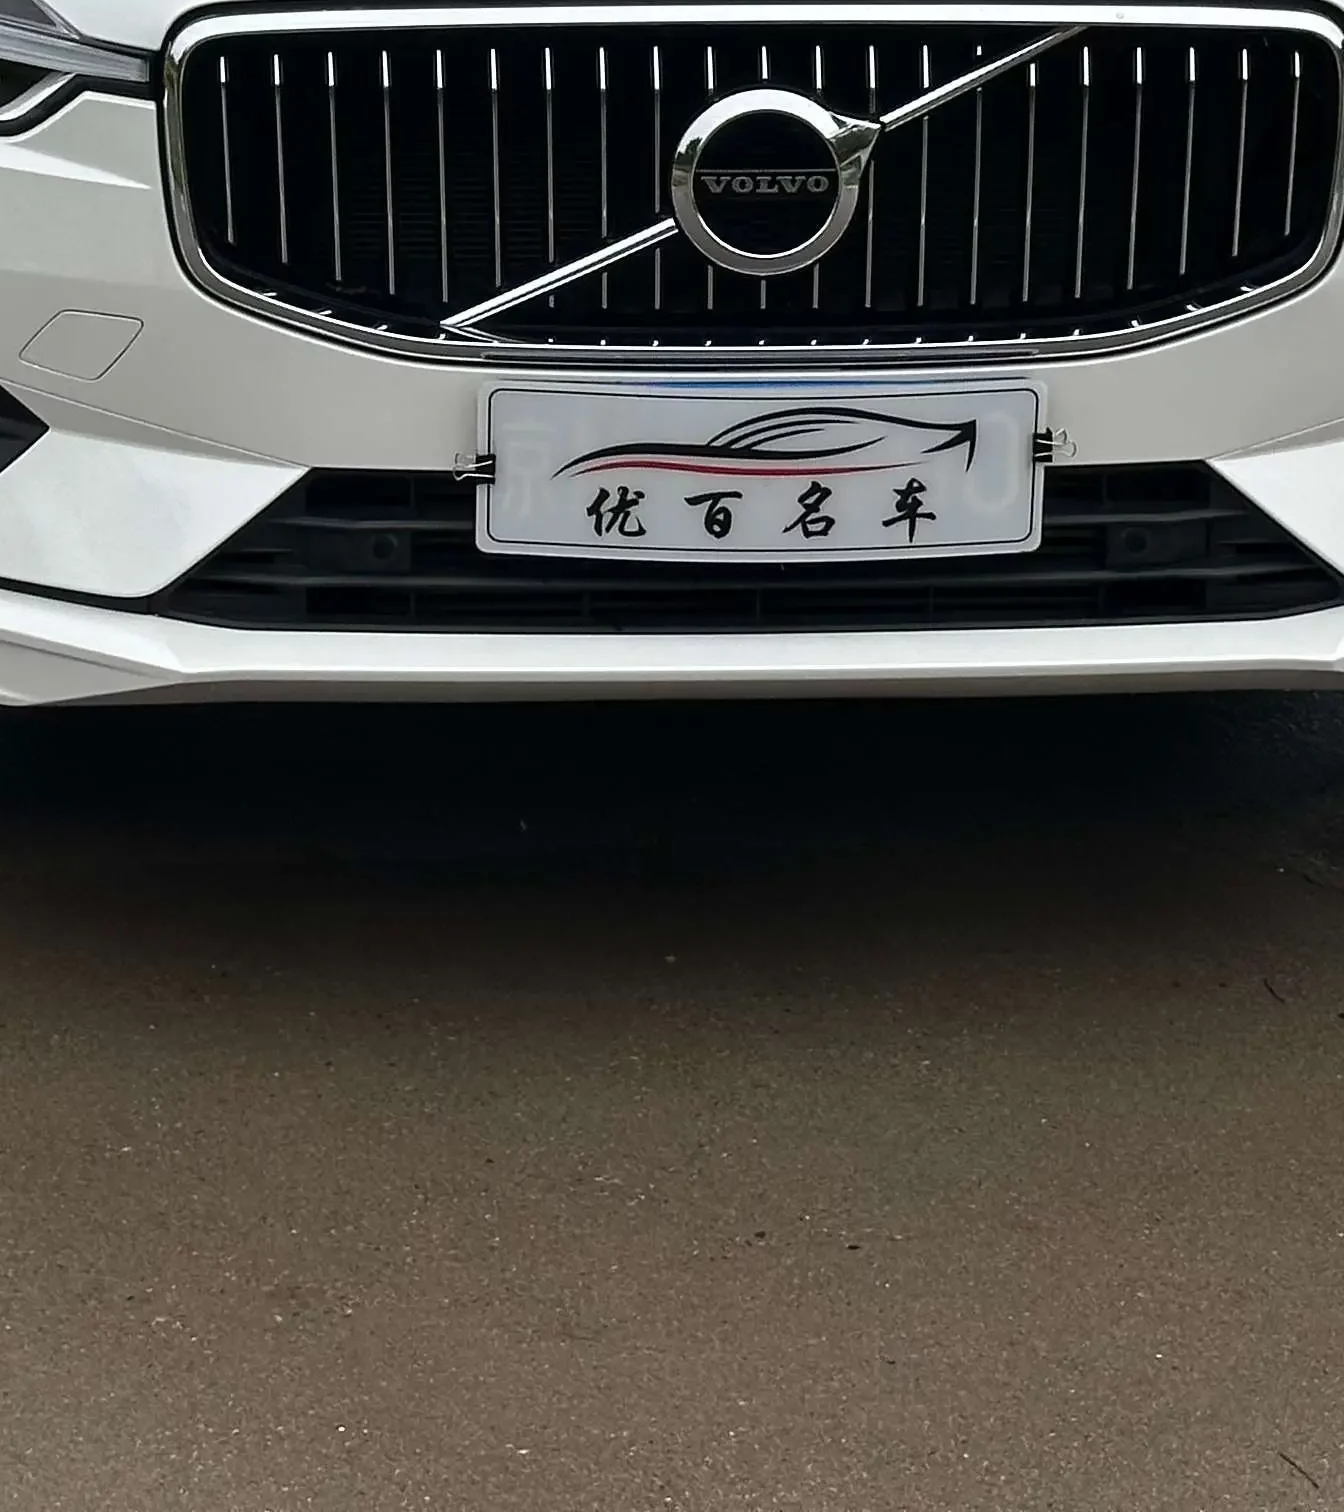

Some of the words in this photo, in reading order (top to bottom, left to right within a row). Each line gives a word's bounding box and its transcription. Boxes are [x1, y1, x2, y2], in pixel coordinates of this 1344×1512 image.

[701, 175, 830, 194] VOLVO
[586, 477, 938, 544] 优百名车
